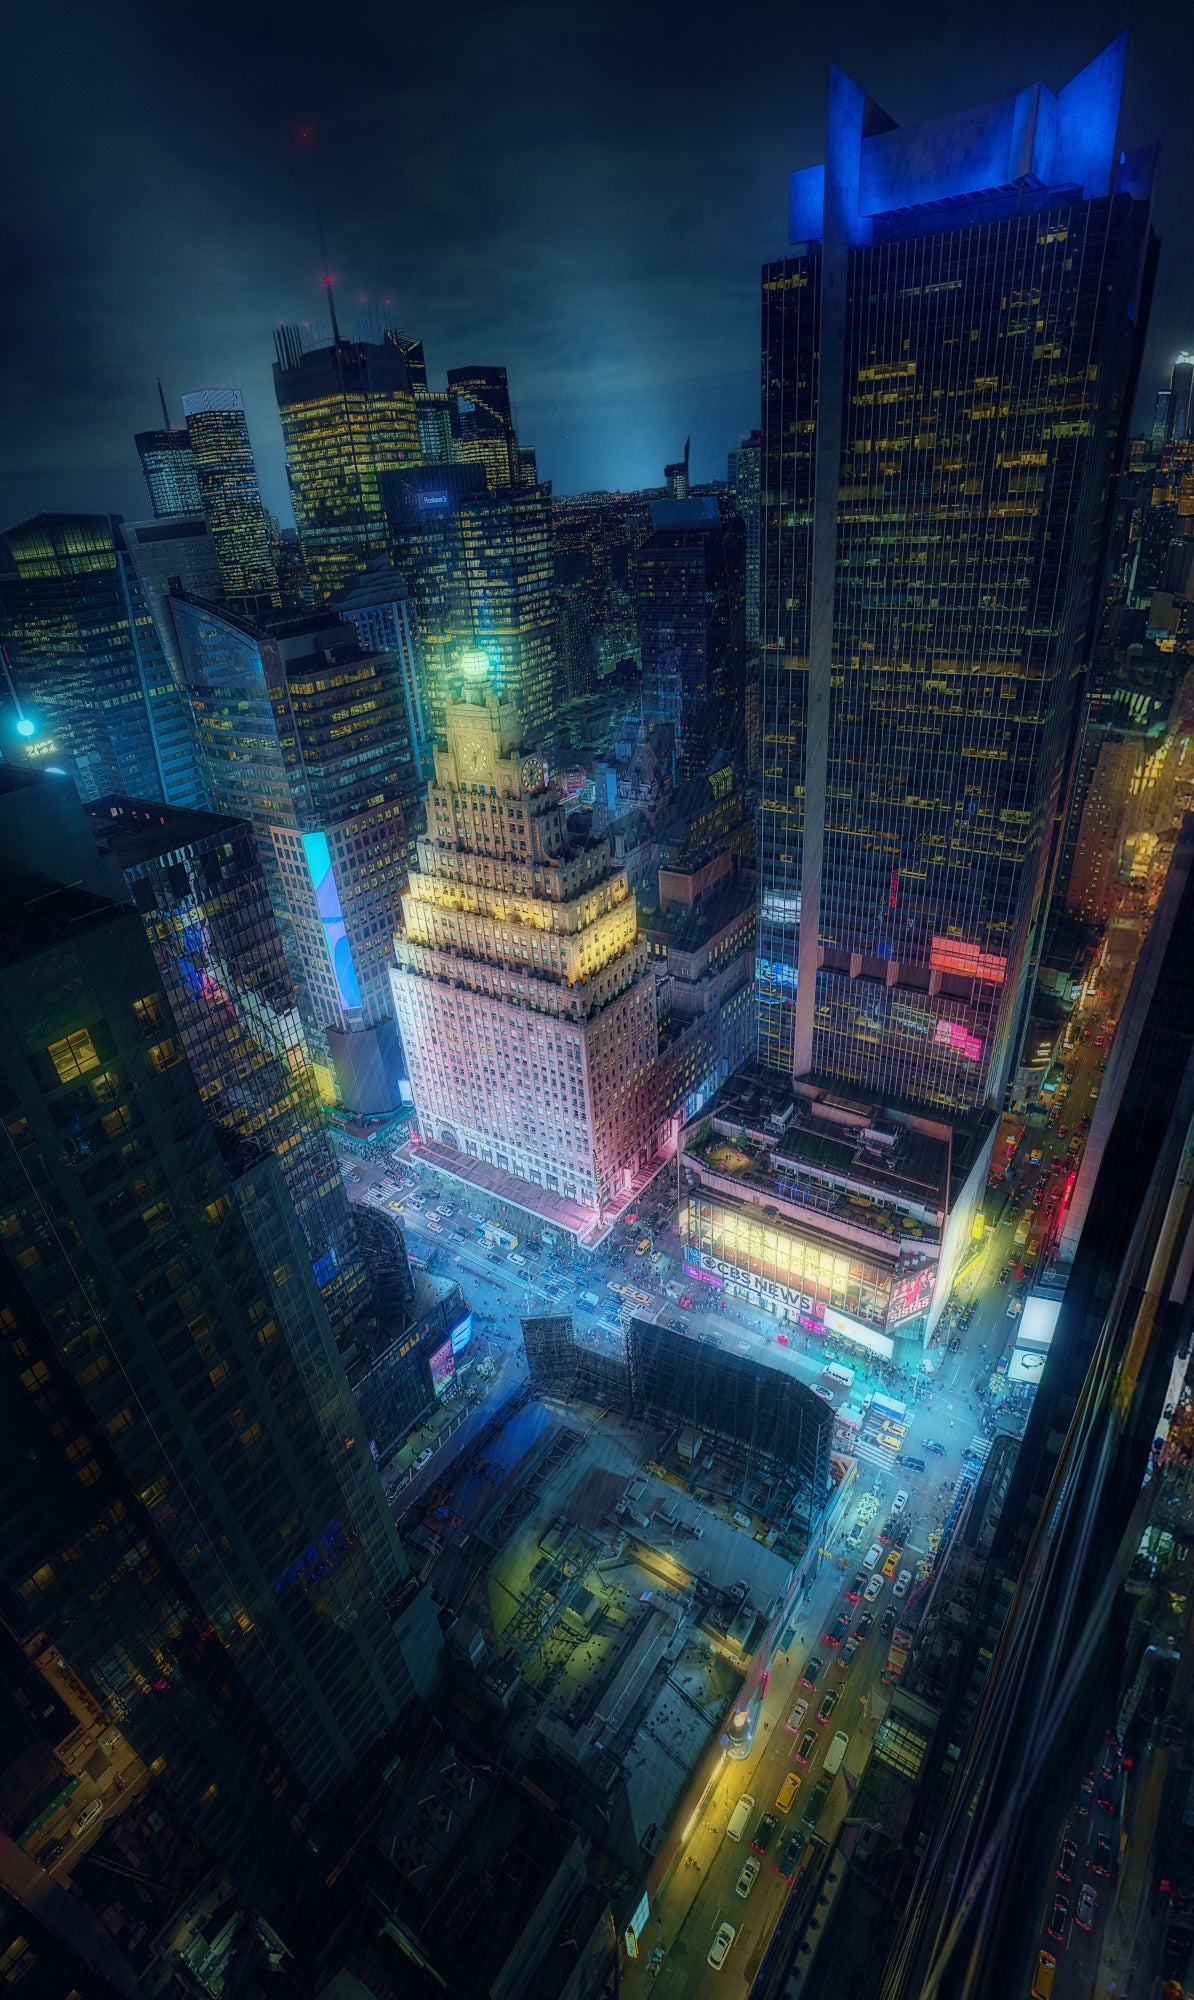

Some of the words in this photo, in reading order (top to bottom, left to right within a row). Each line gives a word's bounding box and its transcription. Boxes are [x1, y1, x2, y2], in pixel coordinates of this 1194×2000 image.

[717, 1263, 751, 1285] CBS
[754, 1277, 810, 1310] NEWS
[889, 1297, 930, 1323] sistas
